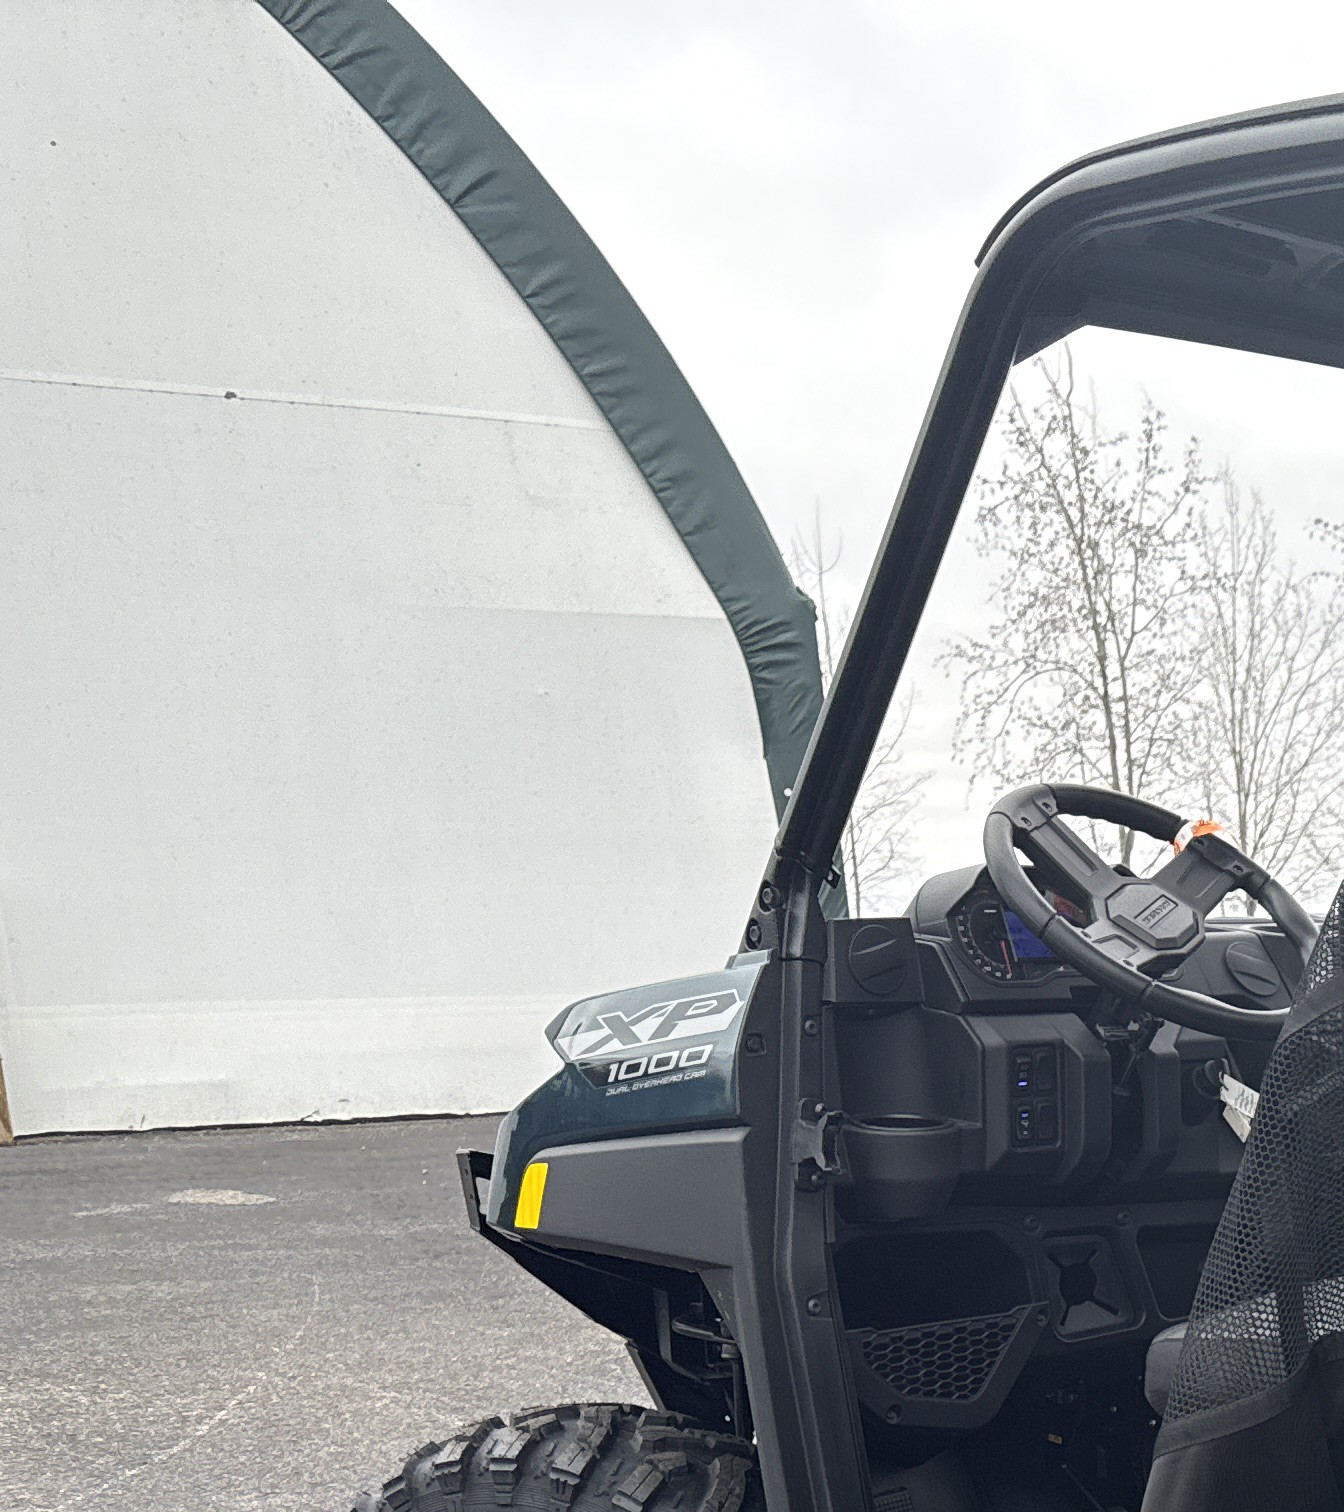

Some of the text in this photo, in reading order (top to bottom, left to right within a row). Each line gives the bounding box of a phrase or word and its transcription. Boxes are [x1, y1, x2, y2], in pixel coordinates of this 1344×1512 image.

[573, 988, 742, 1059] XP
[605, 1069, 707, 1097] DUAL OVERHEAD CAM
[607, 1043, 714, 1083] 1000
